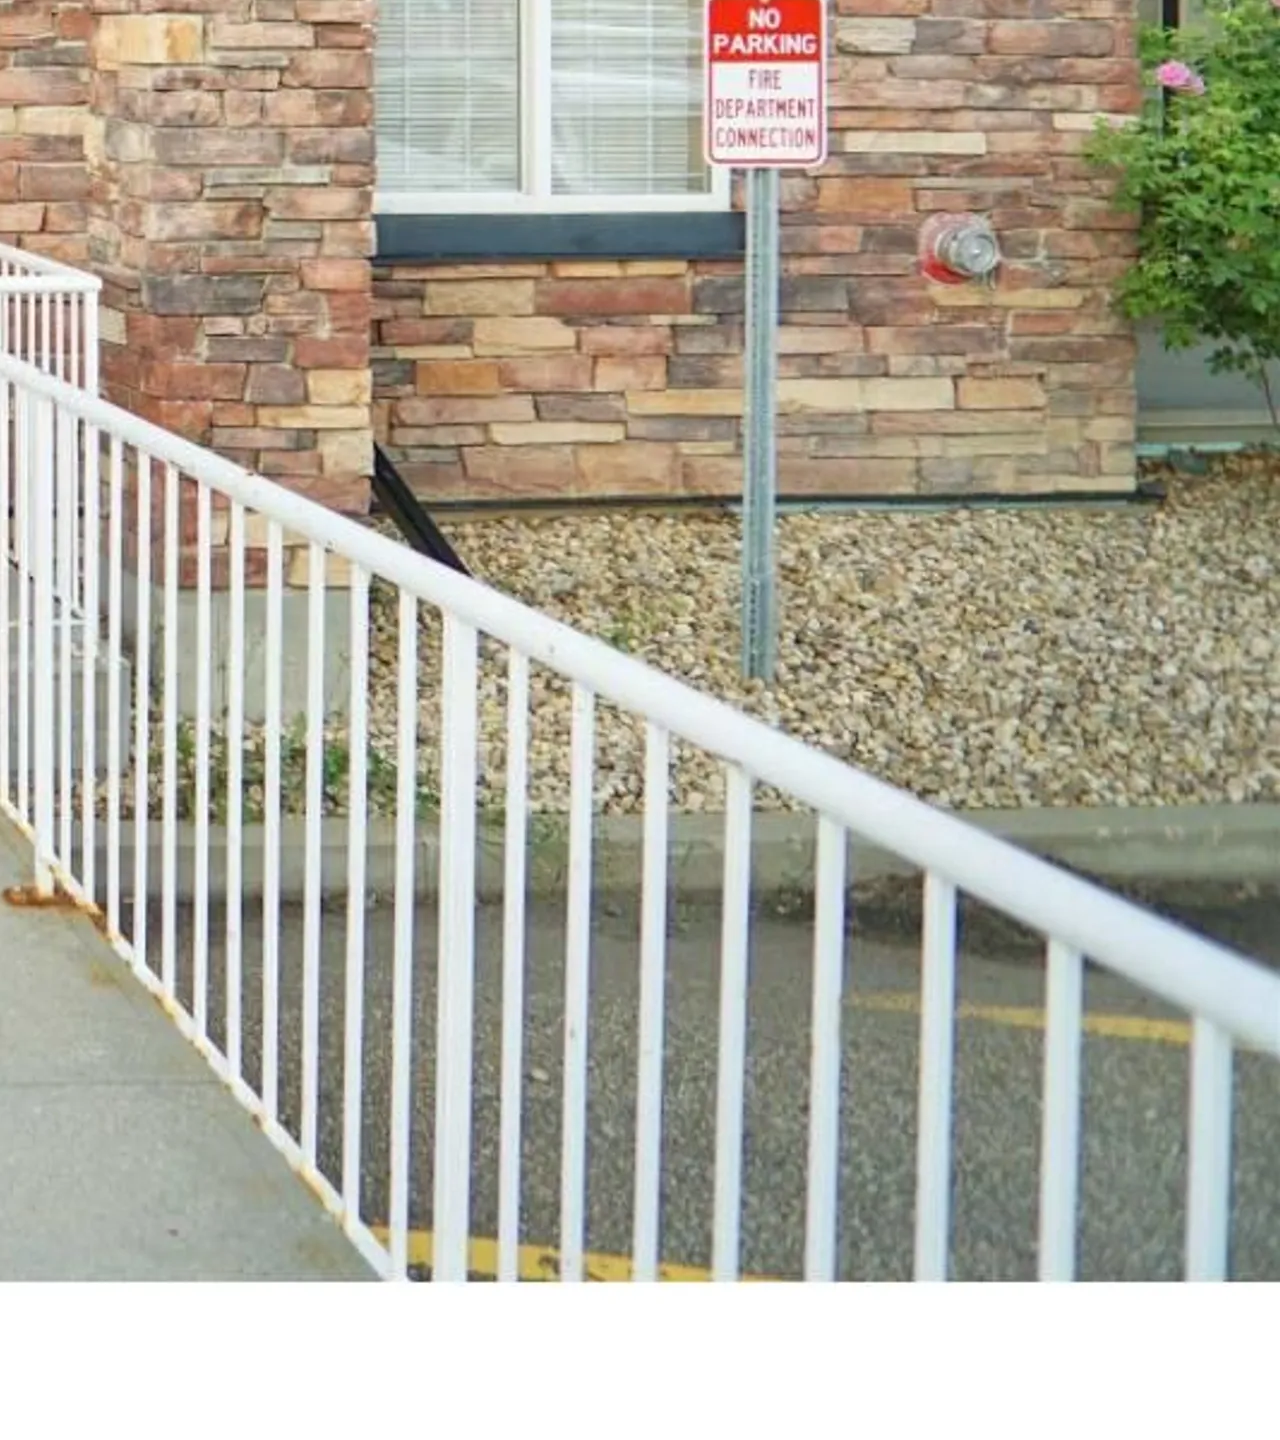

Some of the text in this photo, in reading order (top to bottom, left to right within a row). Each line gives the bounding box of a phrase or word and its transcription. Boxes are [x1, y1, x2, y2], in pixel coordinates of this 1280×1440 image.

[747, 7, 782, 30] NO
[713, 33, 818, 55] PARKING
[748, 69, 782, 90] FIRE
[715, 98, 815, 120] DEPARTMENT
[715, 127, 815, 148] CONNECTION
